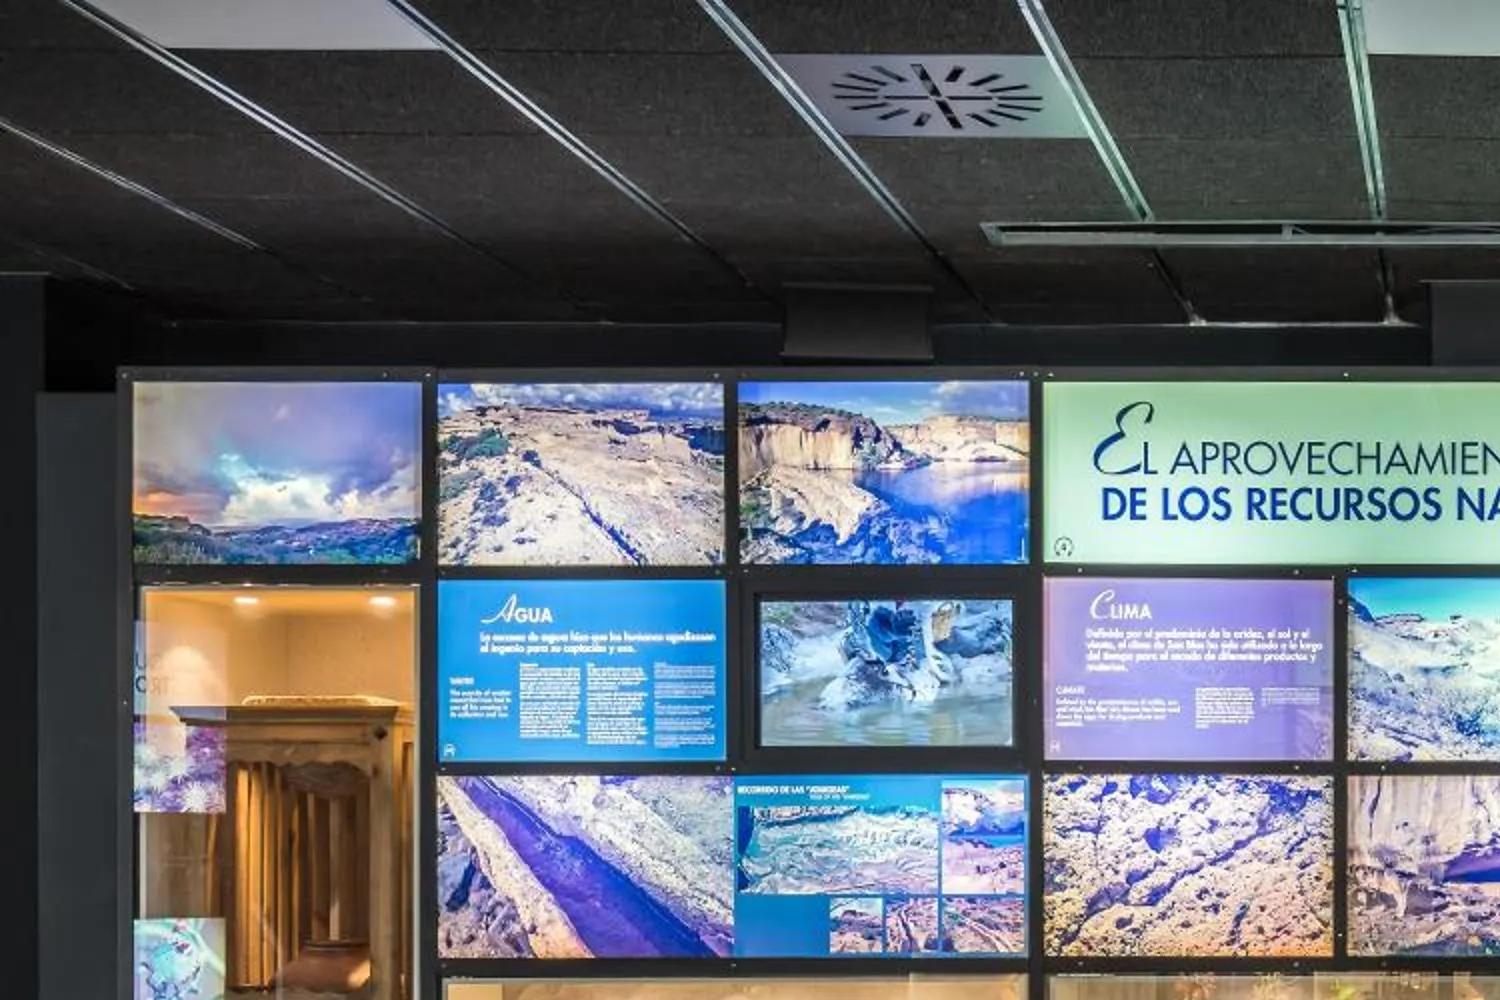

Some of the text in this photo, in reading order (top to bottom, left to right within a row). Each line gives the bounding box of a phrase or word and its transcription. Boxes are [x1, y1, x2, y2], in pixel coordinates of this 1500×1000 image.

[1102, 487, 1147, 521] DE
[1162, 486, 1232, 522] LOS
[1246, 486, 1443, 522] RECURSOS
[481, 593, 553, 624] AGUA
[1090, 589, 1153, 620] CLIMA
